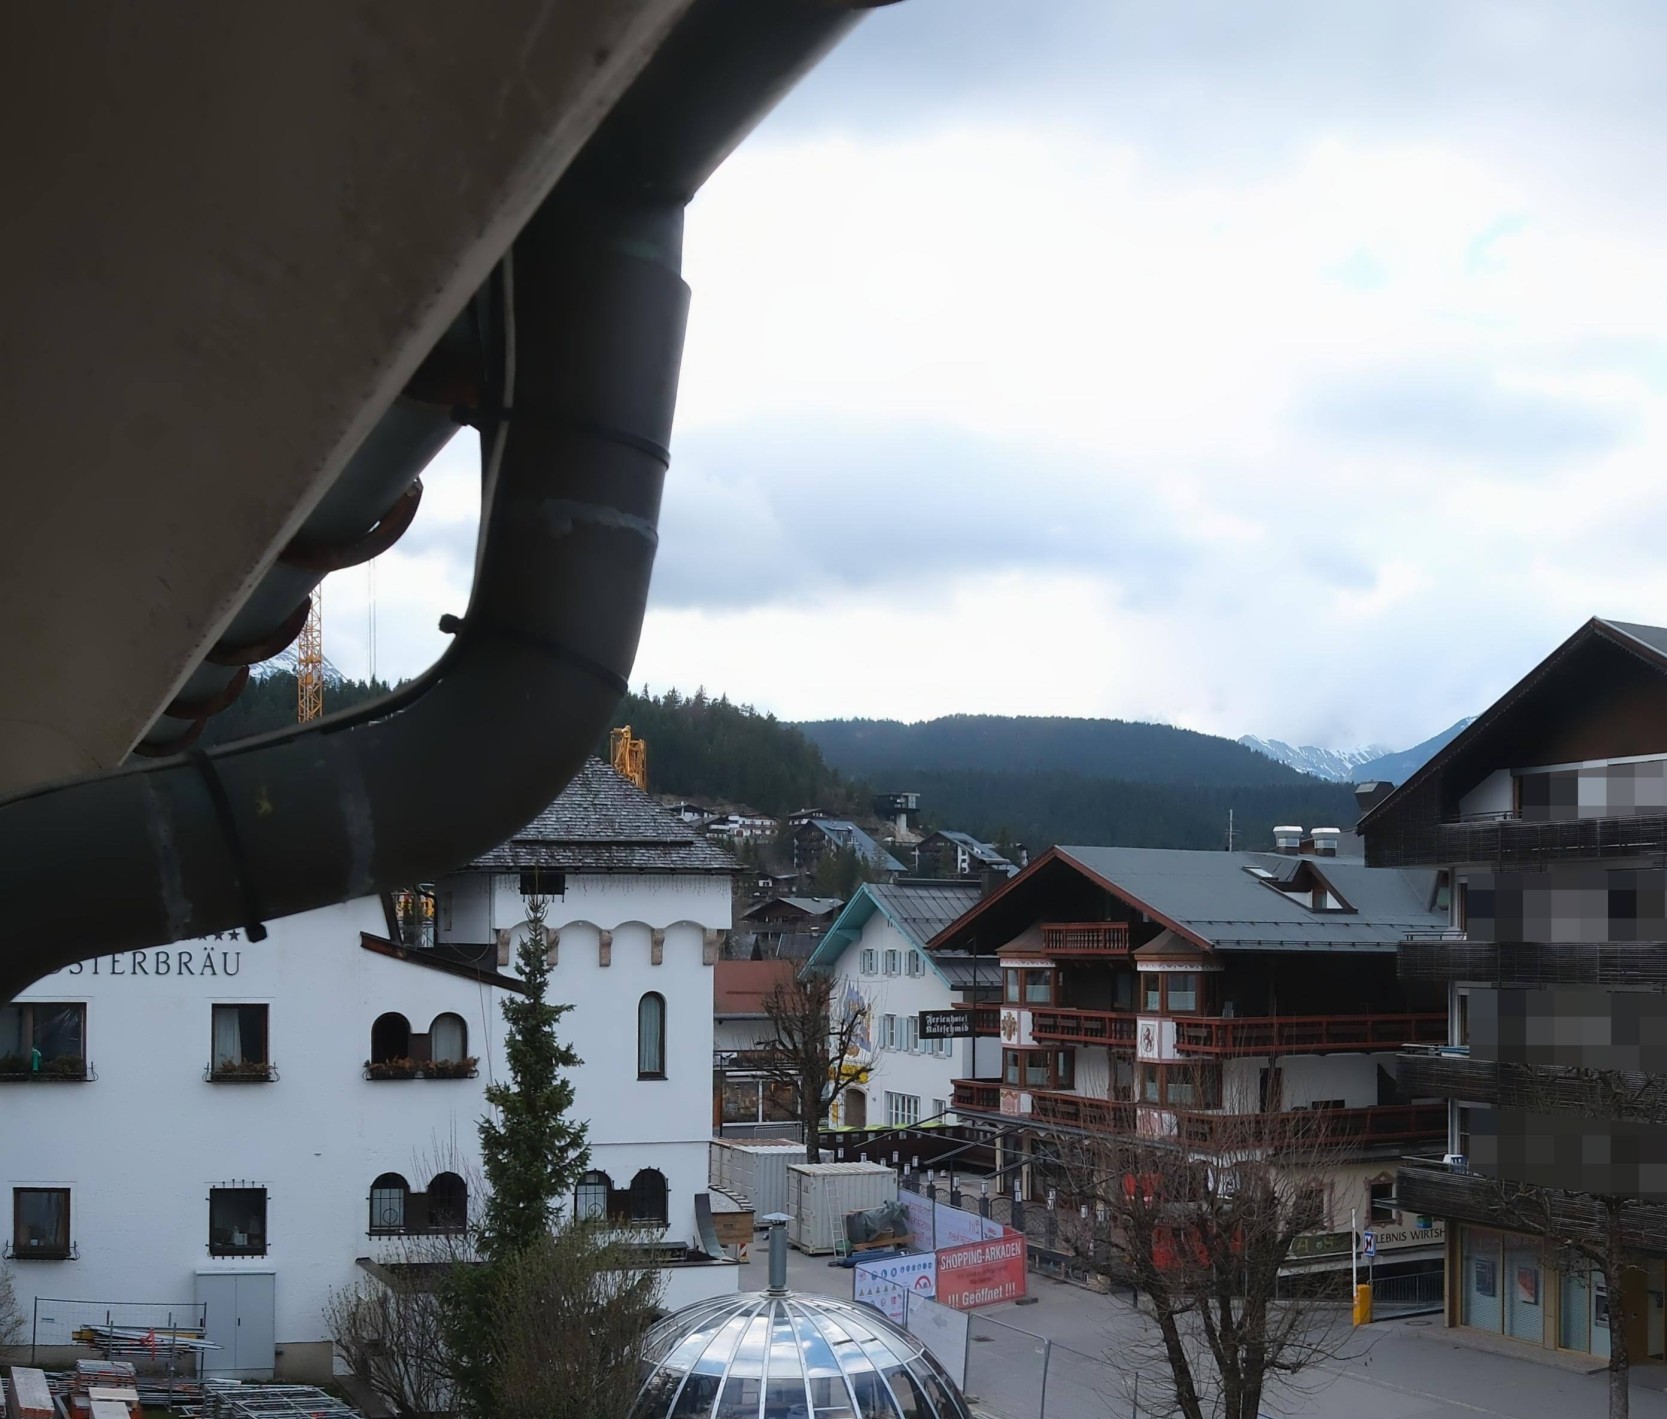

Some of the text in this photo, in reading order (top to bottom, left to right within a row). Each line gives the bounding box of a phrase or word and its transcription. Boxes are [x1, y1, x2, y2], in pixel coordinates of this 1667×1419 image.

[54, 946, 241, 975] STERBRÄU
[940, 1241, 1021, 1271] SHOPPING-ARKADEN
[962, 1285, 1003, 1306] Geöffnet
